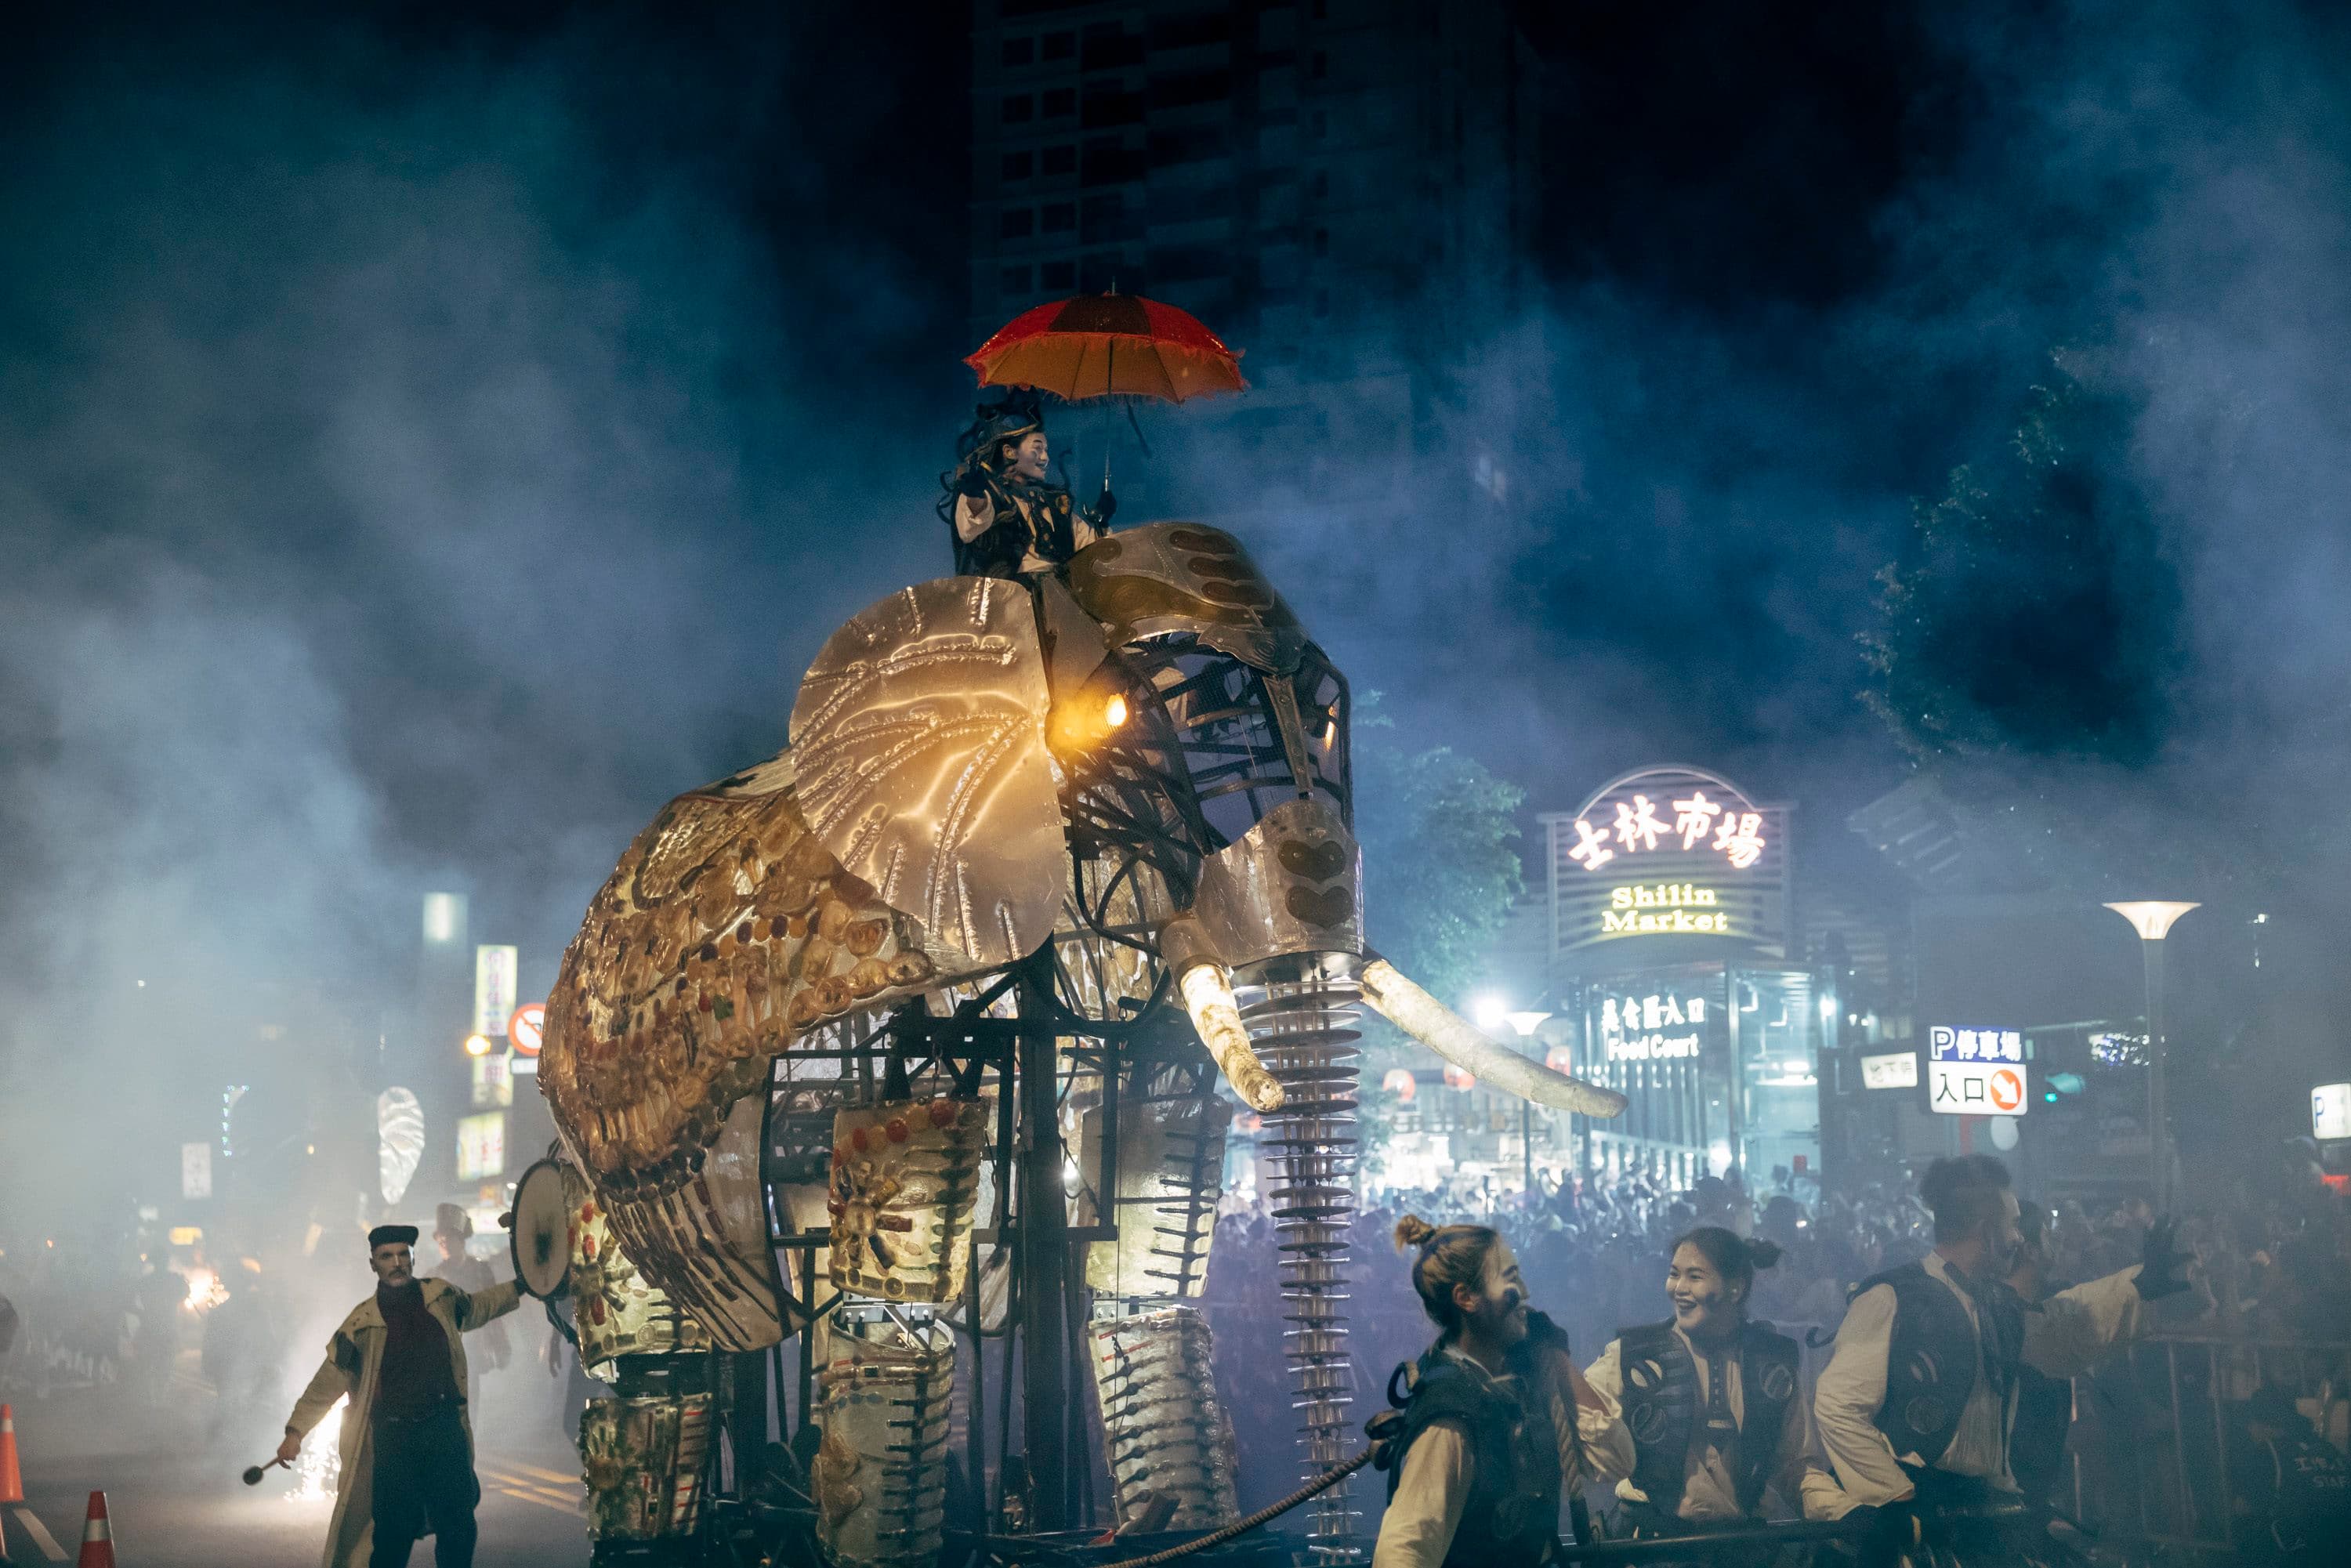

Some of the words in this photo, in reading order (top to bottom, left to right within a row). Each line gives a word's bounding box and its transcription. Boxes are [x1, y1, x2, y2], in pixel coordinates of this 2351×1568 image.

[1568, 791, 1766, 871] 士林市場
[1611, 884, 1717, 909] Shilin
[1602, 910, 1728, 932] Market
[1607, 1035, 1649, 1062] Food
[1650, 1033, 1700, 1059] Court
[1936, 1073, 1984, 1103] 入口
[2313, 1096, 2325, 1128] P
